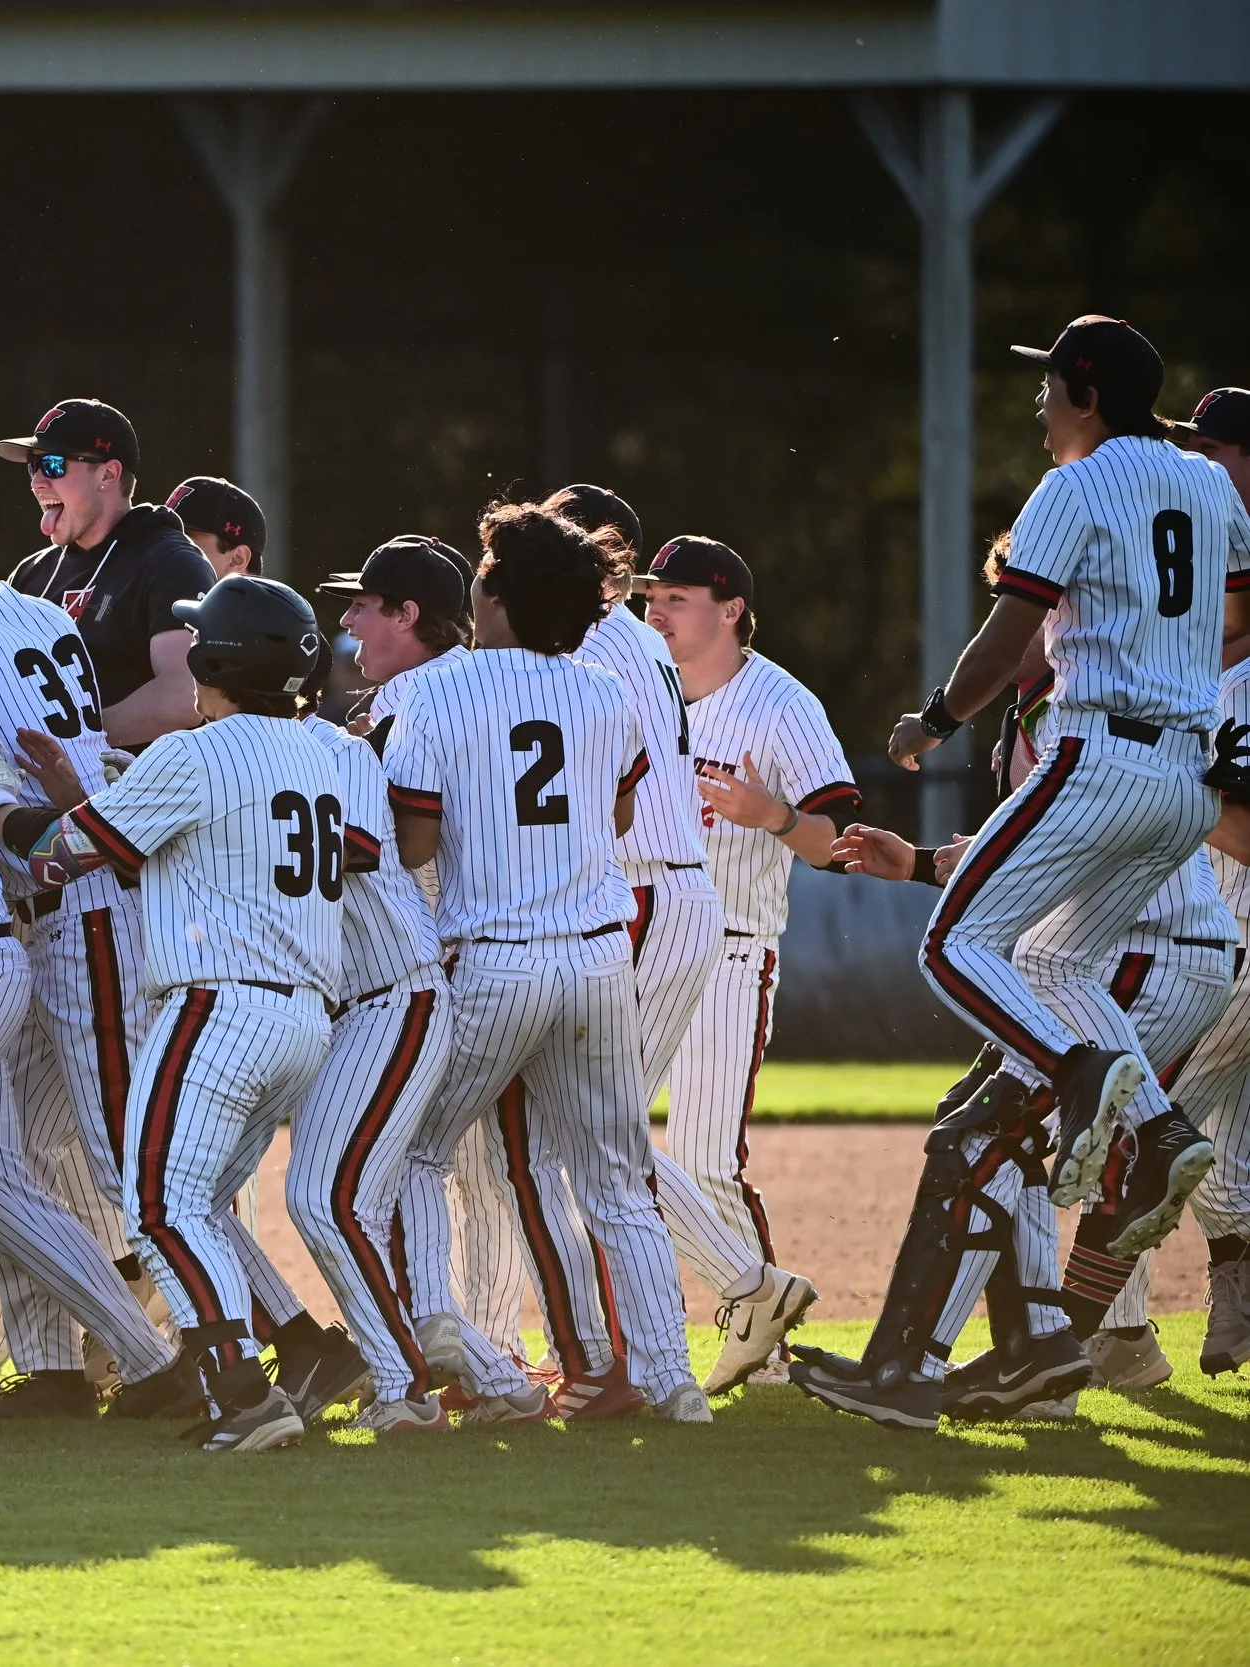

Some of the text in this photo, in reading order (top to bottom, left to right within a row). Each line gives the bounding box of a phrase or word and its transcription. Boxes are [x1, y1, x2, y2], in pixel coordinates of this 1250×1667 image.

[1152, 509, 1194, 618] 8
[14, 633, 103, 739] 33
[509, 719, 569, 827] 2
[271, 790, 343, 903] 36
